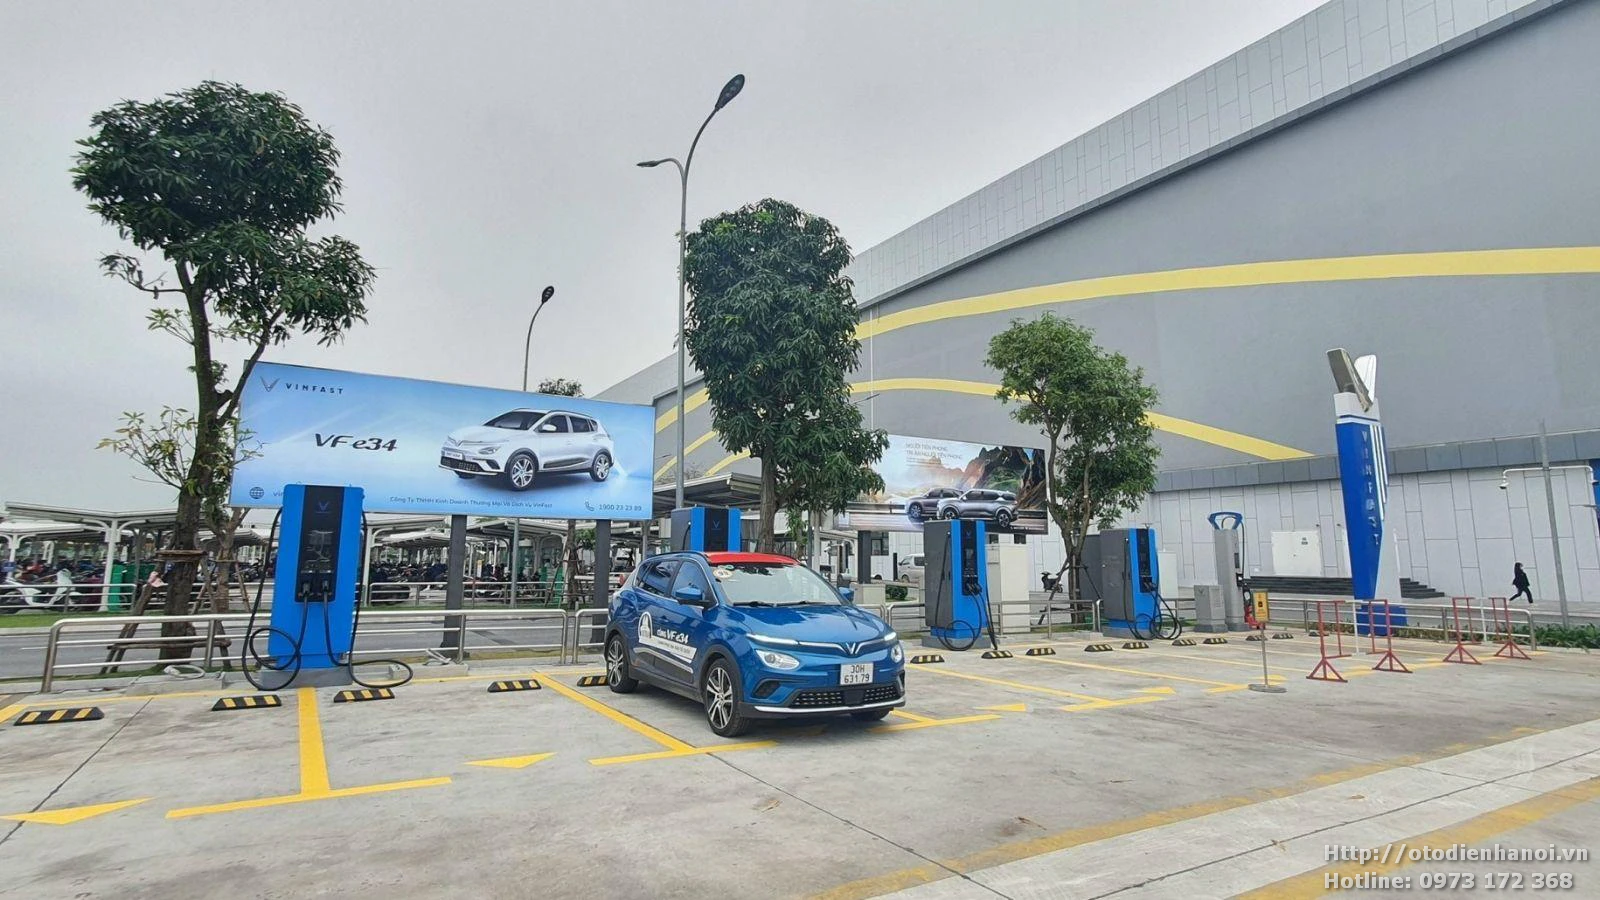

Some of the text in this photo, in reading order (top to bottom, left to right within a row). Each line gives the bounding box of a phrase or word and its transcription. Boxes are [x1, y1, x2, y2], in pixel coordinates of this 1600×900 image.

[286, 382, 344, 394] VINFAST
[315, 433, 398, 451] VF e34
[850, 665, 865, 673] 30H
[844, 674, 869, 683] 631.79
